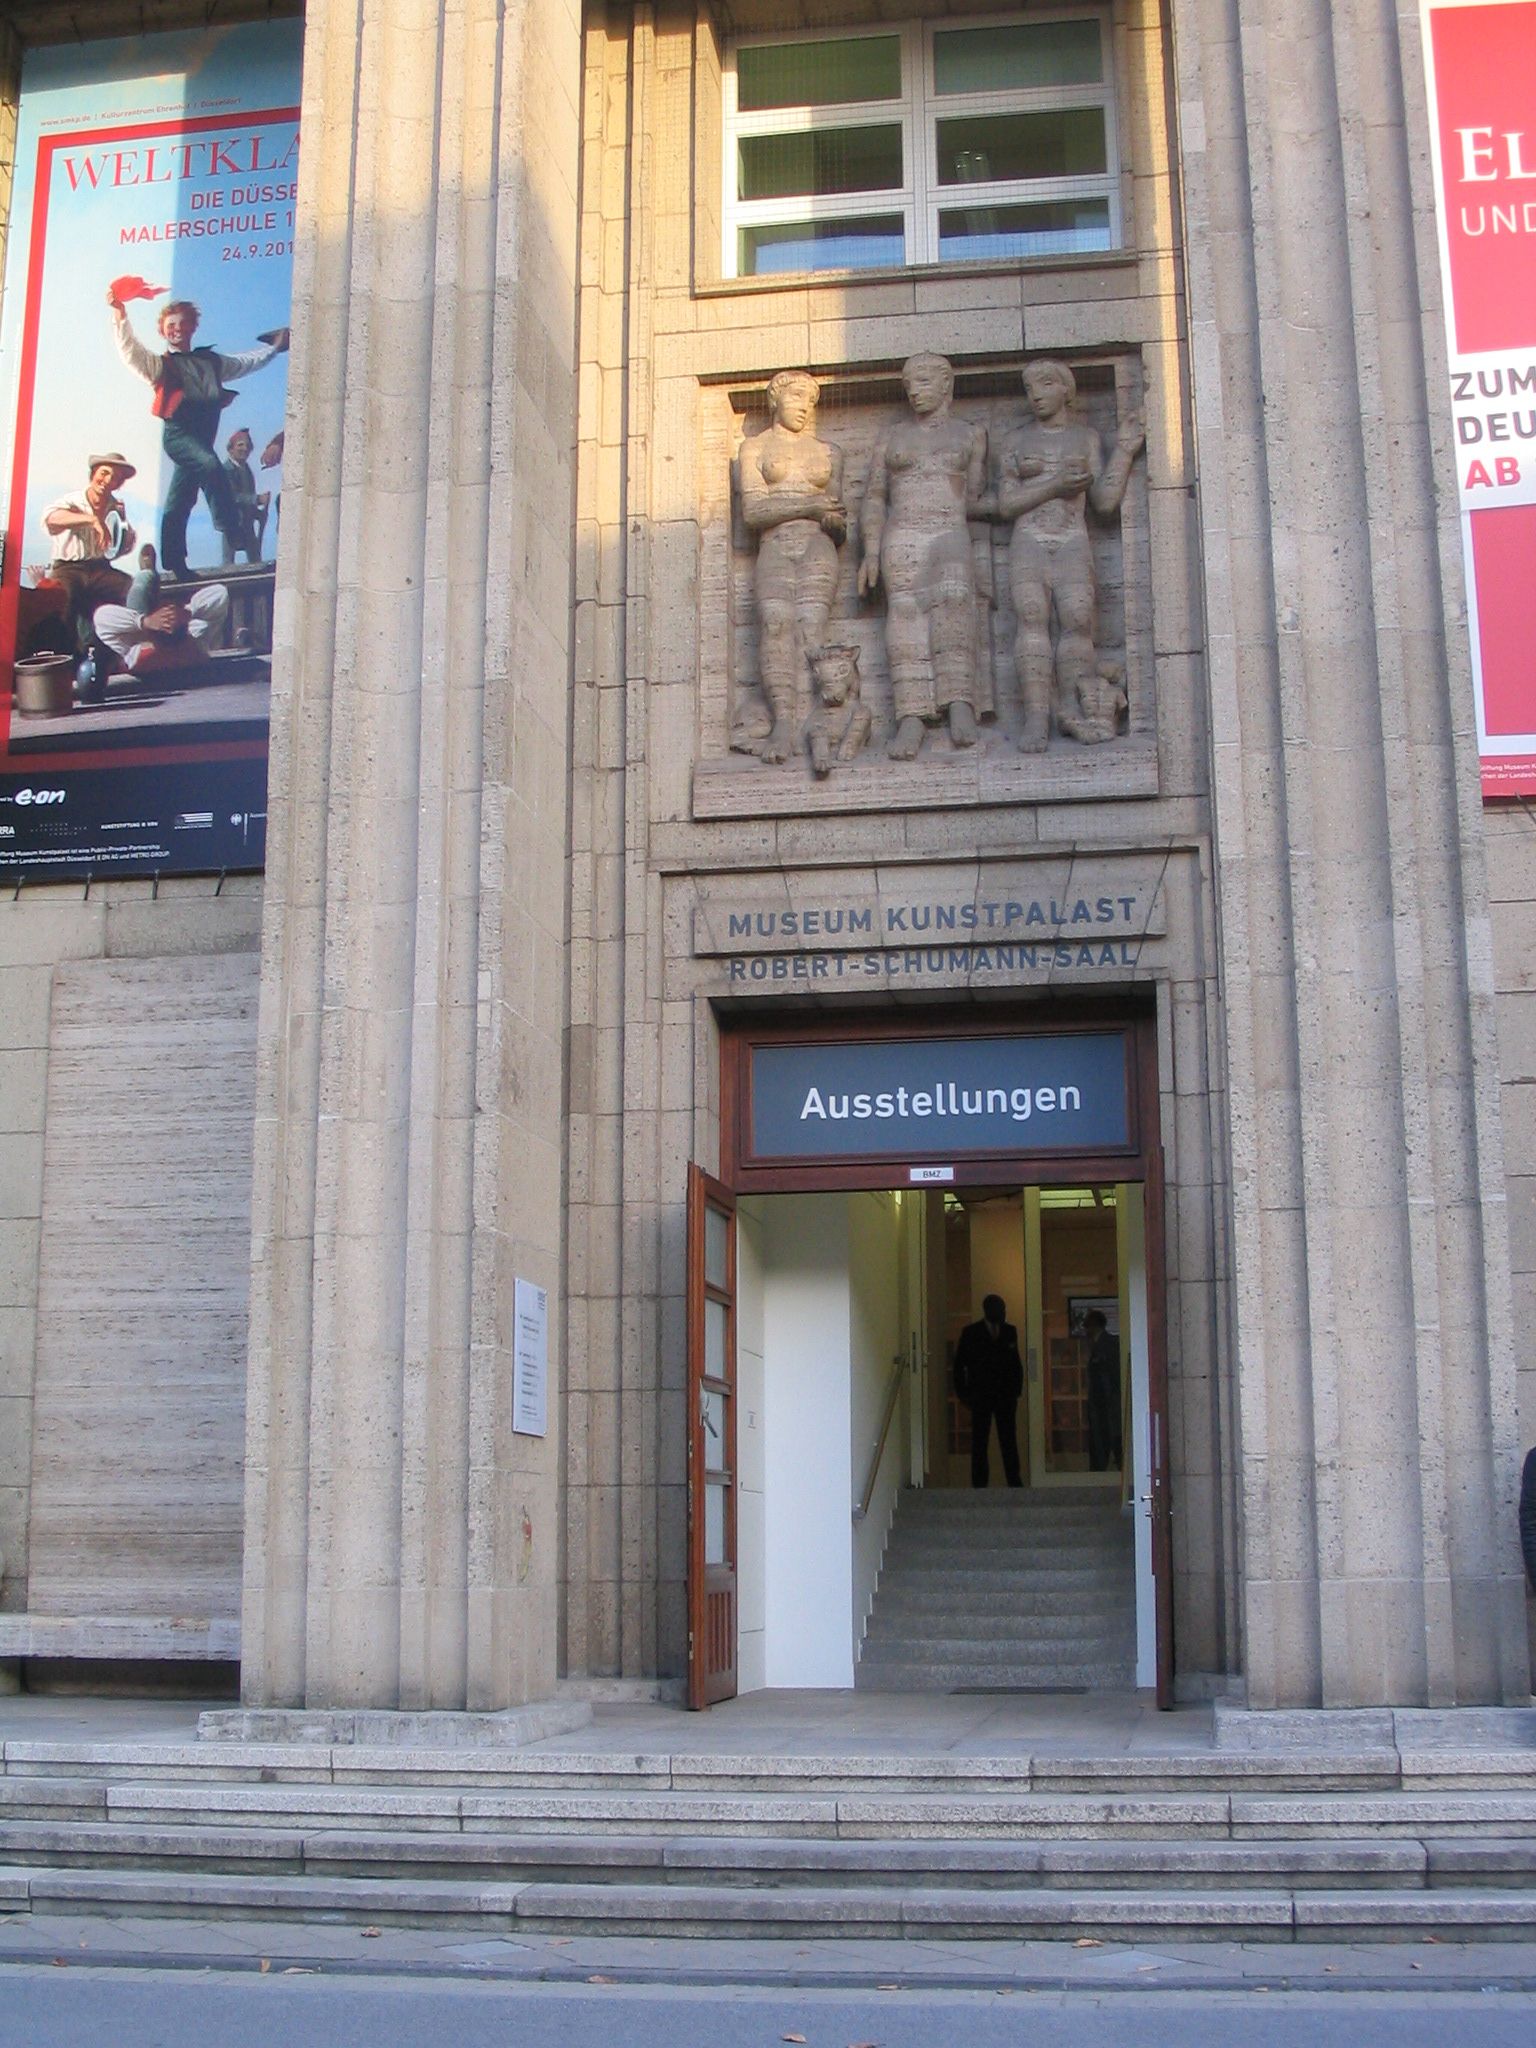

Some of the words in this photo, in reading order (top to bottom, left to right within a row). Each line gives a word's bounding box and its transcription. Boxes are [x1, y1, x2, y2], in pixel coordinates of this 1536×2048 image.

[191, 190, 224, 210] DIE
[120, 212, 277, 245] MALERSCHULE
[1465, 457, 1521, 490] AB
[728, 909, 872, 938] MUSEUM
[886, 897, 1137, 931] KUNSTPALAST
[729, 944, 1139, 981] ROBERT-SCHUMANN-SAAL
[800, 1082, 1082, 1121] Ausstellungen
